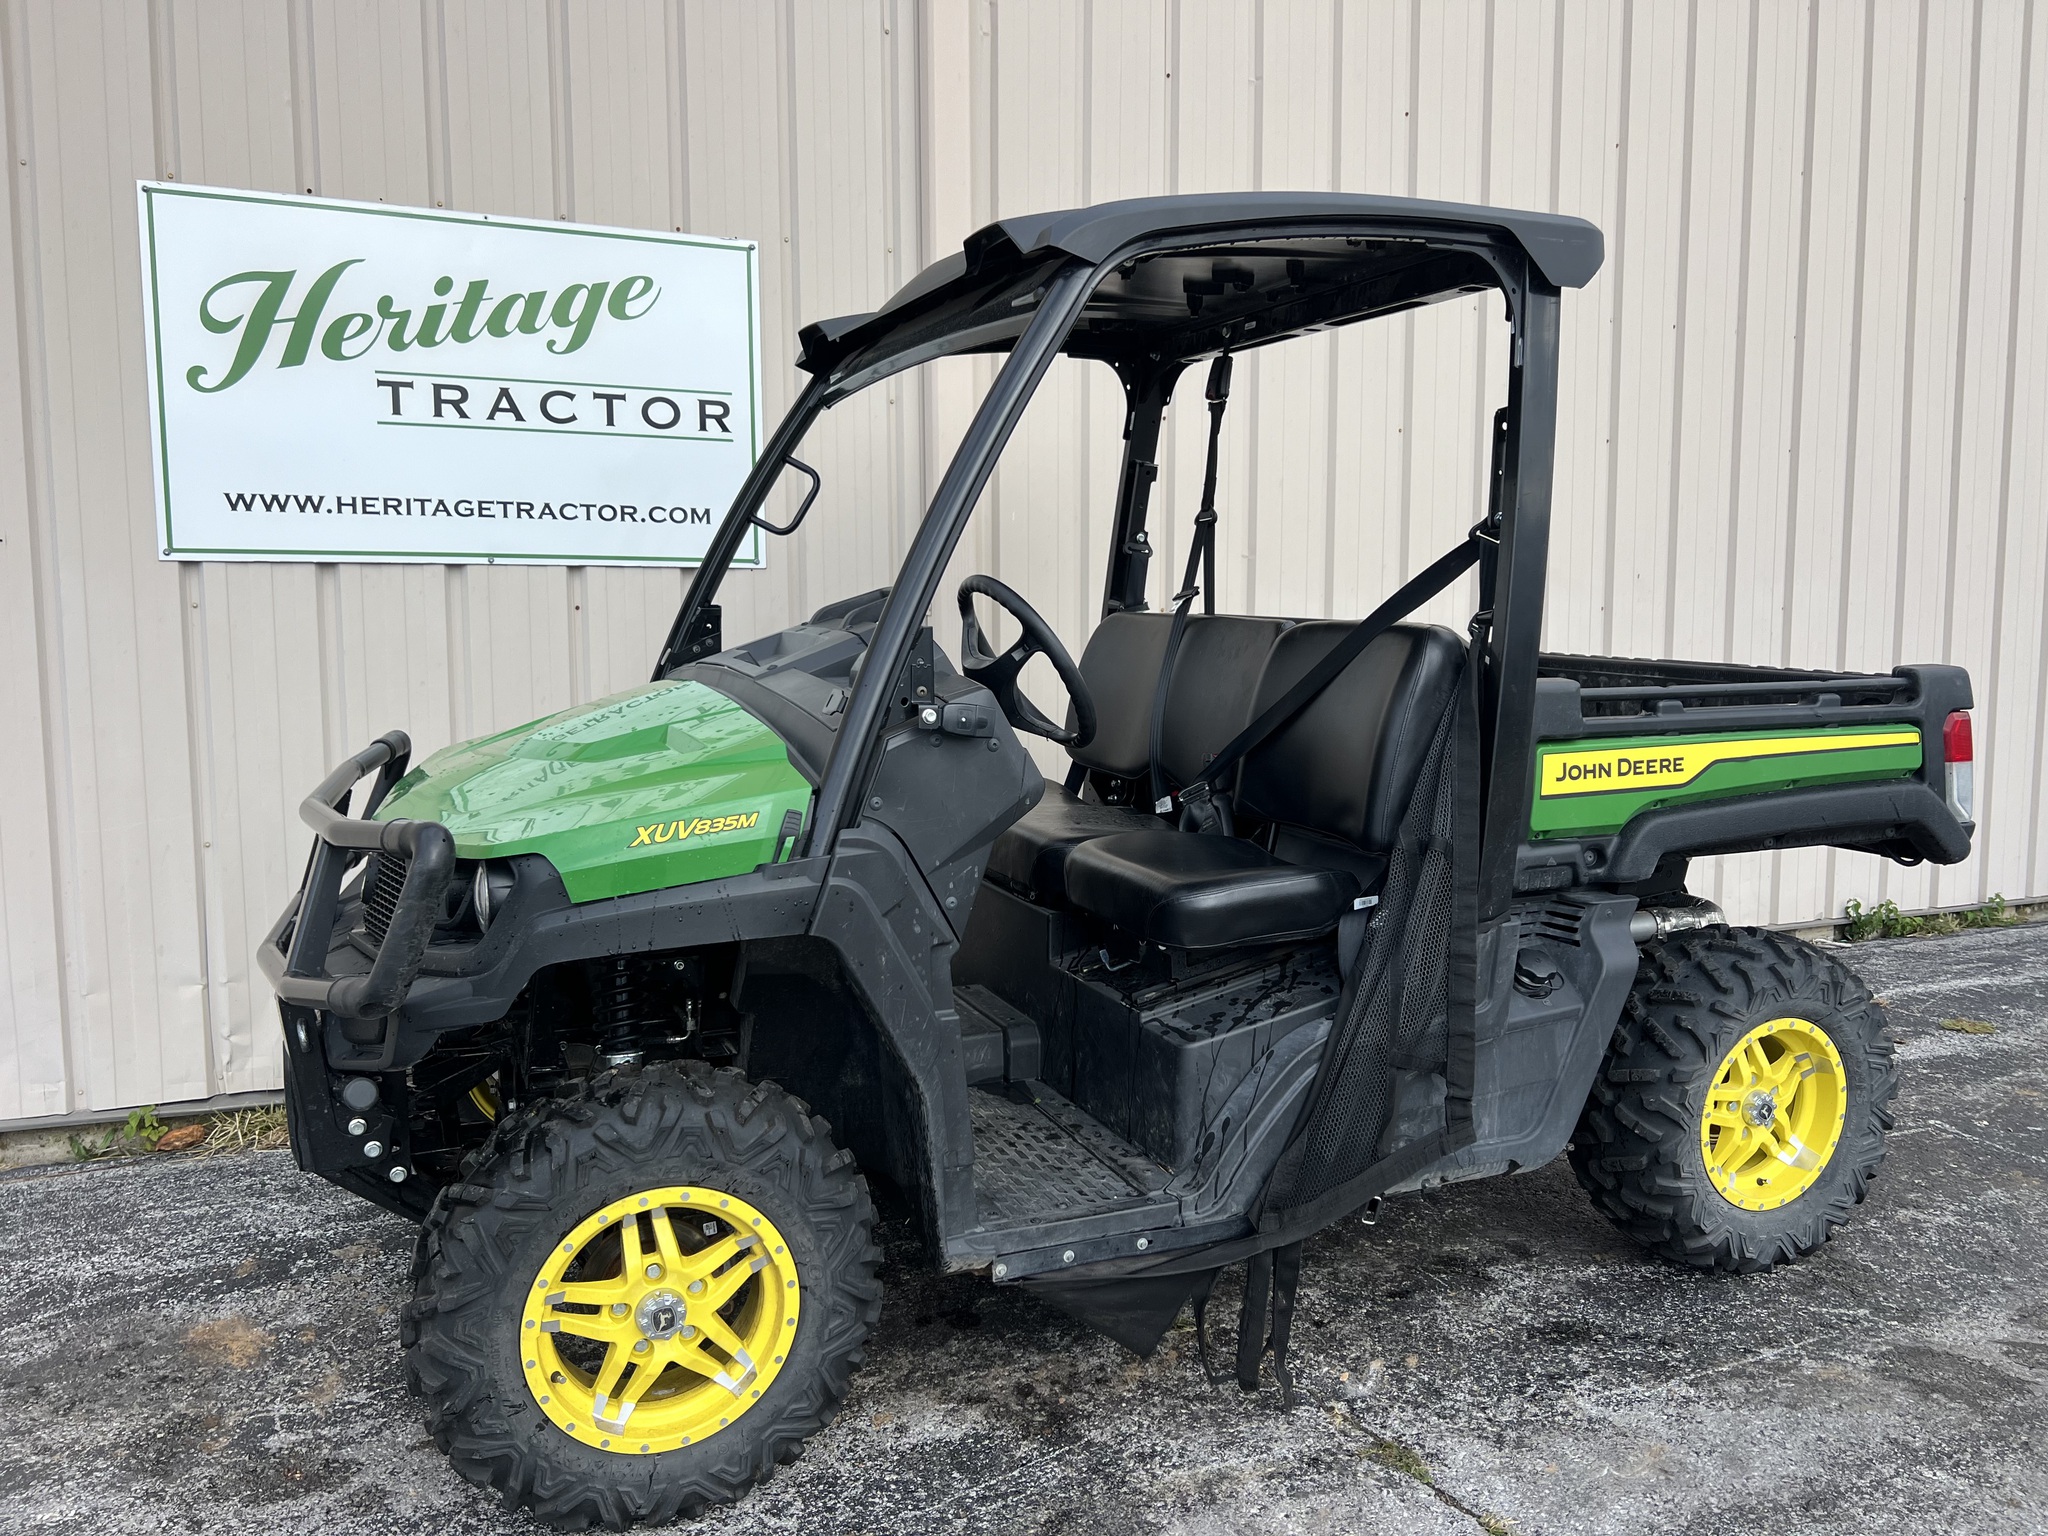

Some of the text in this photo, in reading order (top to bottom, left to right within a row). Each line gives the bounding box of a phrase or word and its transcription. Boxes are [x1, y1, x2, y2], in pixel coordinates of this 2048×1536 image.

[186, 258, 662, 394] Heritage
[376, 378, 732, 434] TRACTOR
[223, 492, 712, 526] WWW.HERITAGETRACTOR.COM
[1555, 757, 1685, 782] JOHN DEERE
[627, 811, 760, 848] XUV835M
